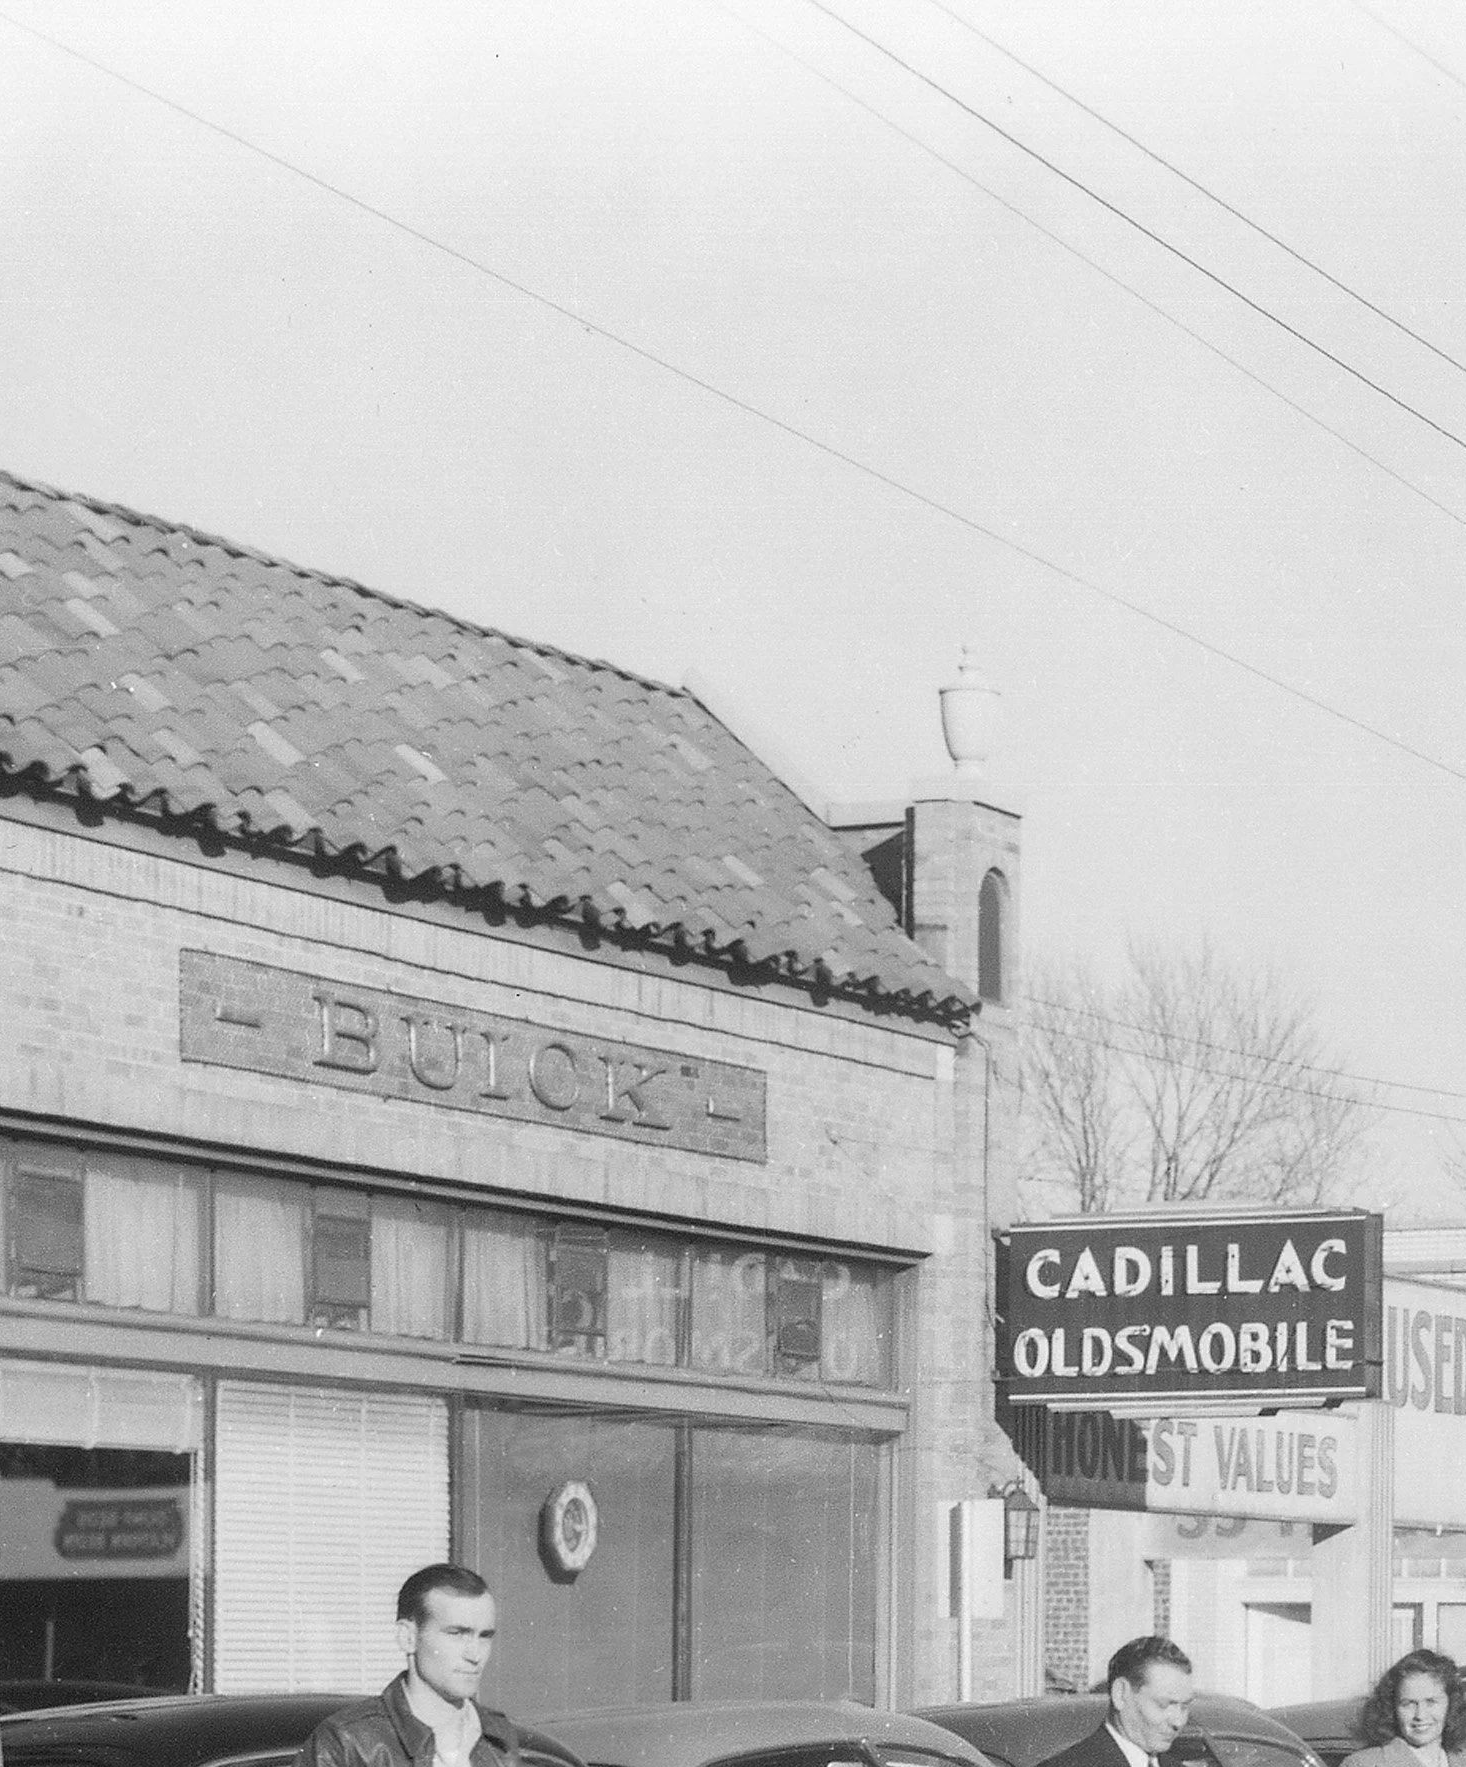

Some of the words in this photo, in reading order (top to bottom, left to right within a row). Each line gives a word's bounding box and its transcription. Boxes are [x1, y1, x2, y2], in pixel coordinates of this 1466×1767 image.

[312, 996, 671, 1130] BUICK
[1026, 1238, 1346, 1299] CADILLAC
[1013, 1319, 1354, 1378] OLDSMOBILE
[1213, 1424, 1338, 1499] VALUES
